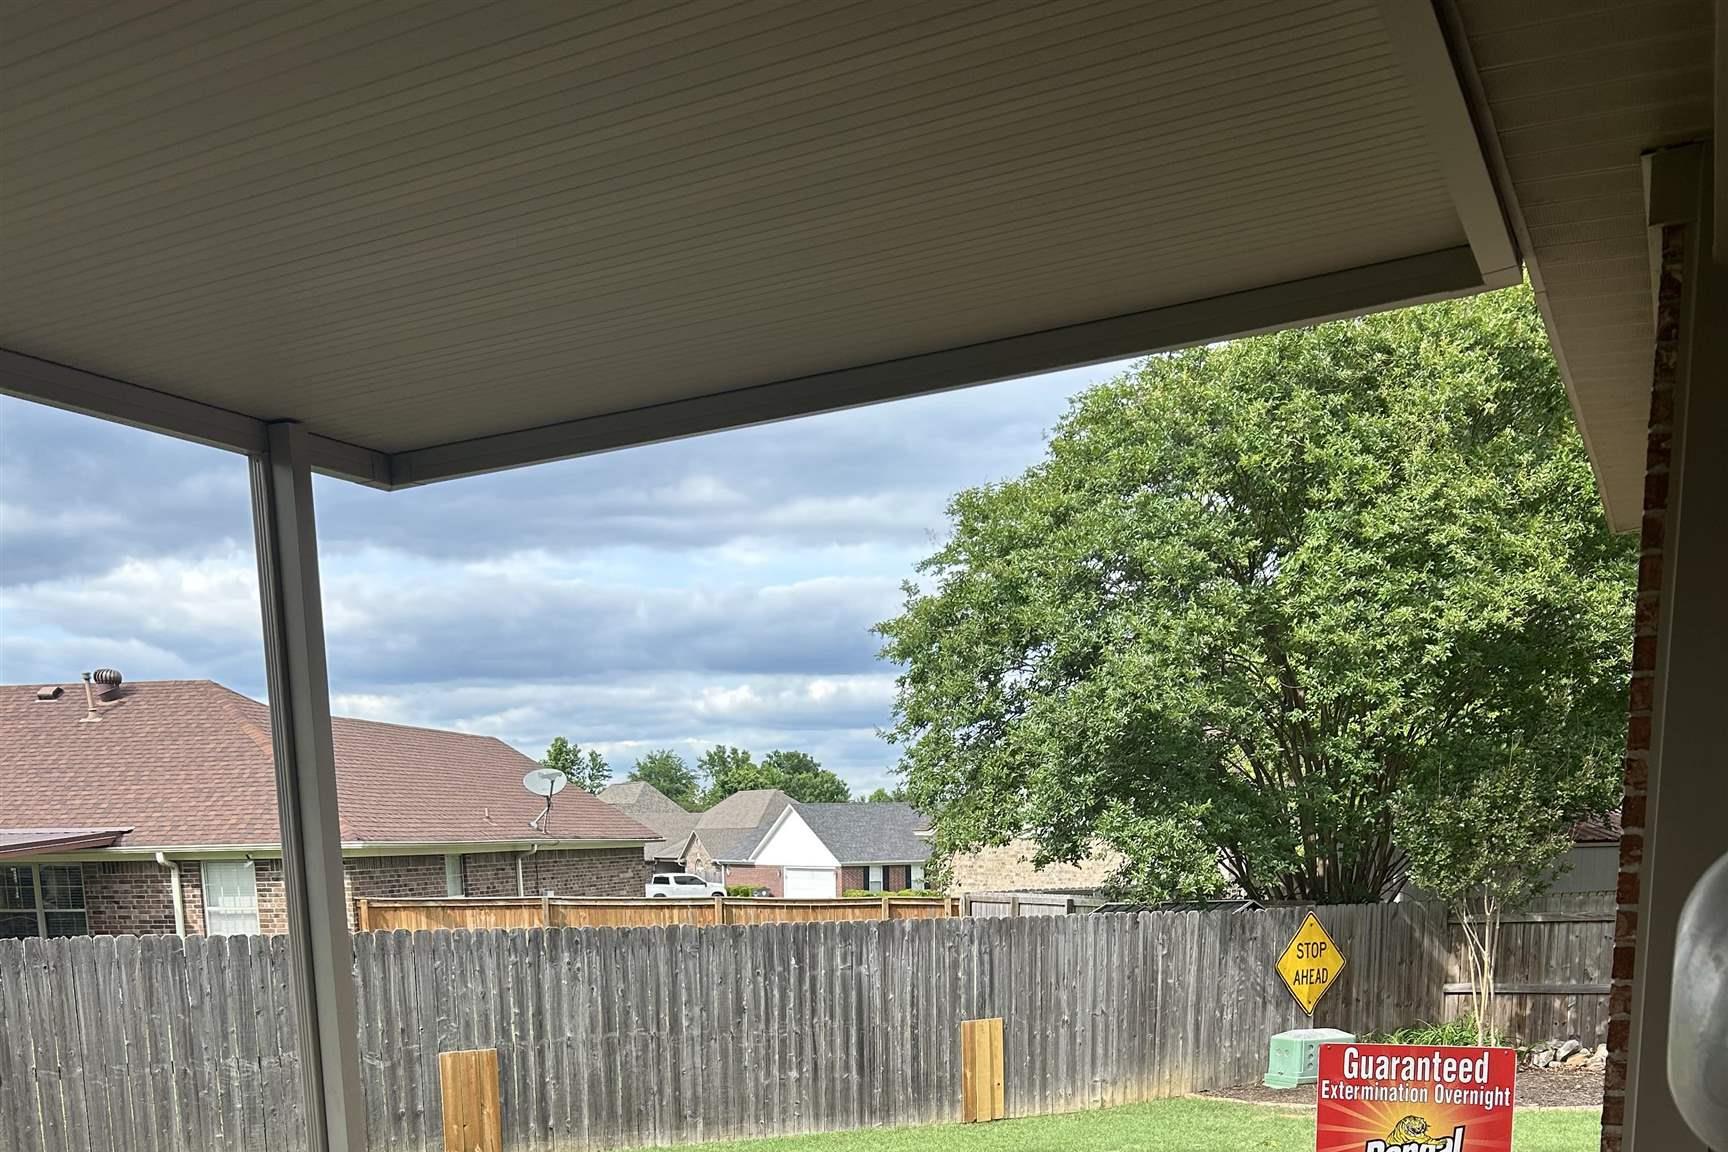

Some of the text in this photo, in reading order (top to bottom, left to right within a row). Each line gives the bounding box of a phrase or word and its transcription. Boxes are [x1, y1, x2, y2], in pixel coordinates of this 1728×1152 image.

[1296, 941, 1328, 959] STOP
[1293, 967, 1329, 986] AHEAD
[1343, 1046, 1490, 1084] Guaranteed
[1321, 1079, 1511, 1111] Extermination Overnight
